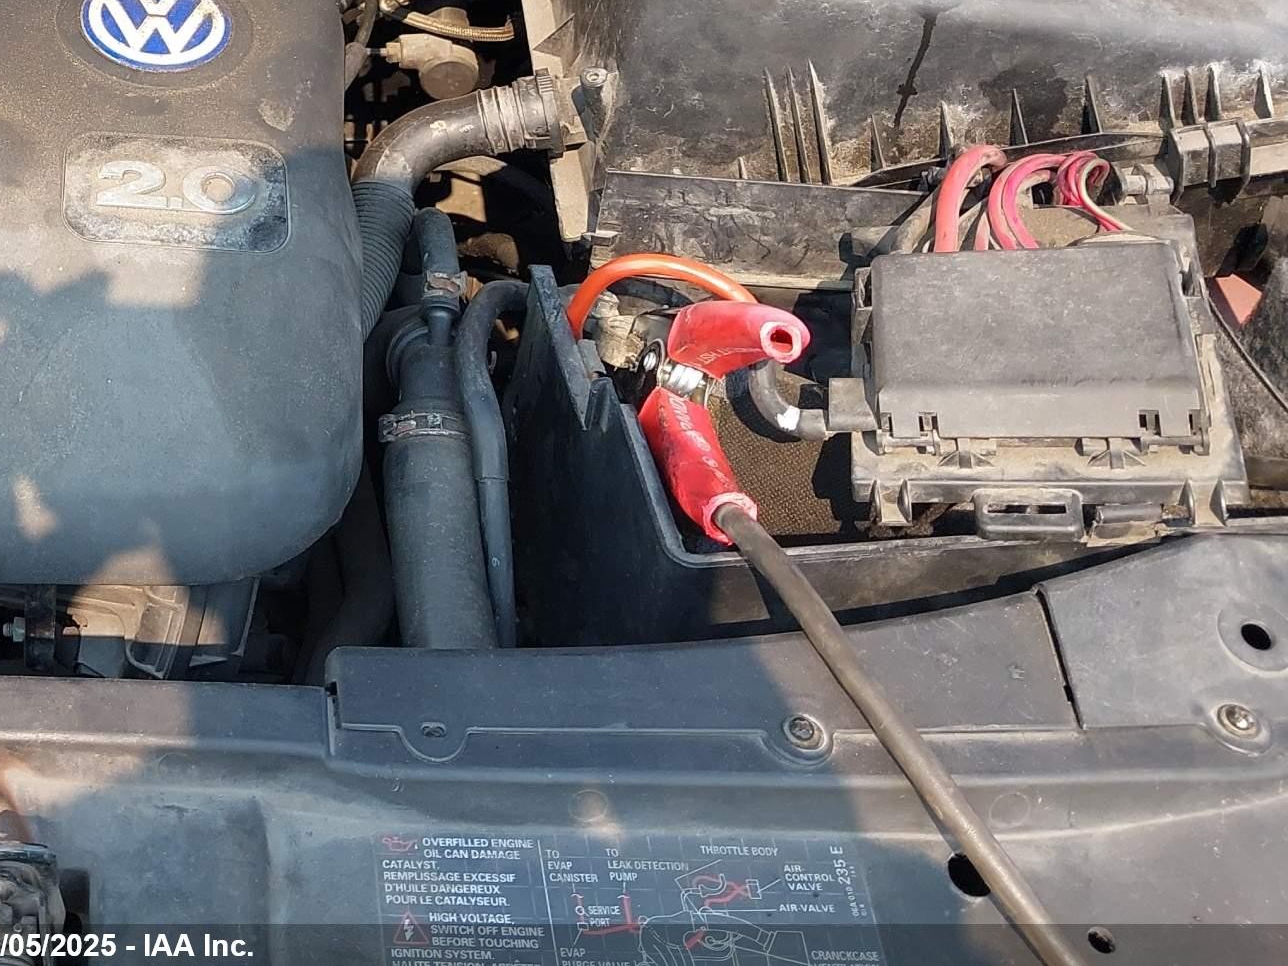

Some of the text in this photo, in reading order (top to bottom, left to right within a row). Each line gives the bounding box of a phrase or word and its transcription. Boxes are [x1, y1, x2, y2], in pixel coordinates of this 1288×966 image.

[96, 159, 256, 215] 2.0
[422, 837, 534, 849] OVERFILLED ENGINE
[423, 849, 521, 860] OIL CAN DAMAGE
[545, 849, 560, 859] TO
[605, 848, 619, 857] TO
[699, 845, 779, 857] THROTTLE BODY
[829, 845, 843, 855] E
[382, 859, 440, 870] CATALYST.
[547, 861, 573, 870] EVAP
[607, 860, 689, 871] LEAK DETECTION
[383, 871, 517, 882] REMPLISSAGE EXCESSIF
[549, 873, 599, 882] CANISTER
[609, 872, 638, 882] PUMP
[785, 873, 835, 882] CONTROL
[833, 859, 851, 885] 235
[385, 883, 500, 894] D'HUILE DANGEREUX
[788, 882, 823, 891] VALVE
[386, 895, 510, 907] POUR LE CATALYSEUR.
[587, 905, 621, 916] SERVICE
[428, 912, 515, 925] HIGH VOLTAGE.
[589, 917, 610, 927] PORT
[430, 925, 545, 937] SWITCH OFF ENGINE
[432, 937, 540, 949] BEFORE TOUCHING
[391, 948, 495, 960] IGNITION SYSTEM.
[560, 947, 586, 957] EVAP
